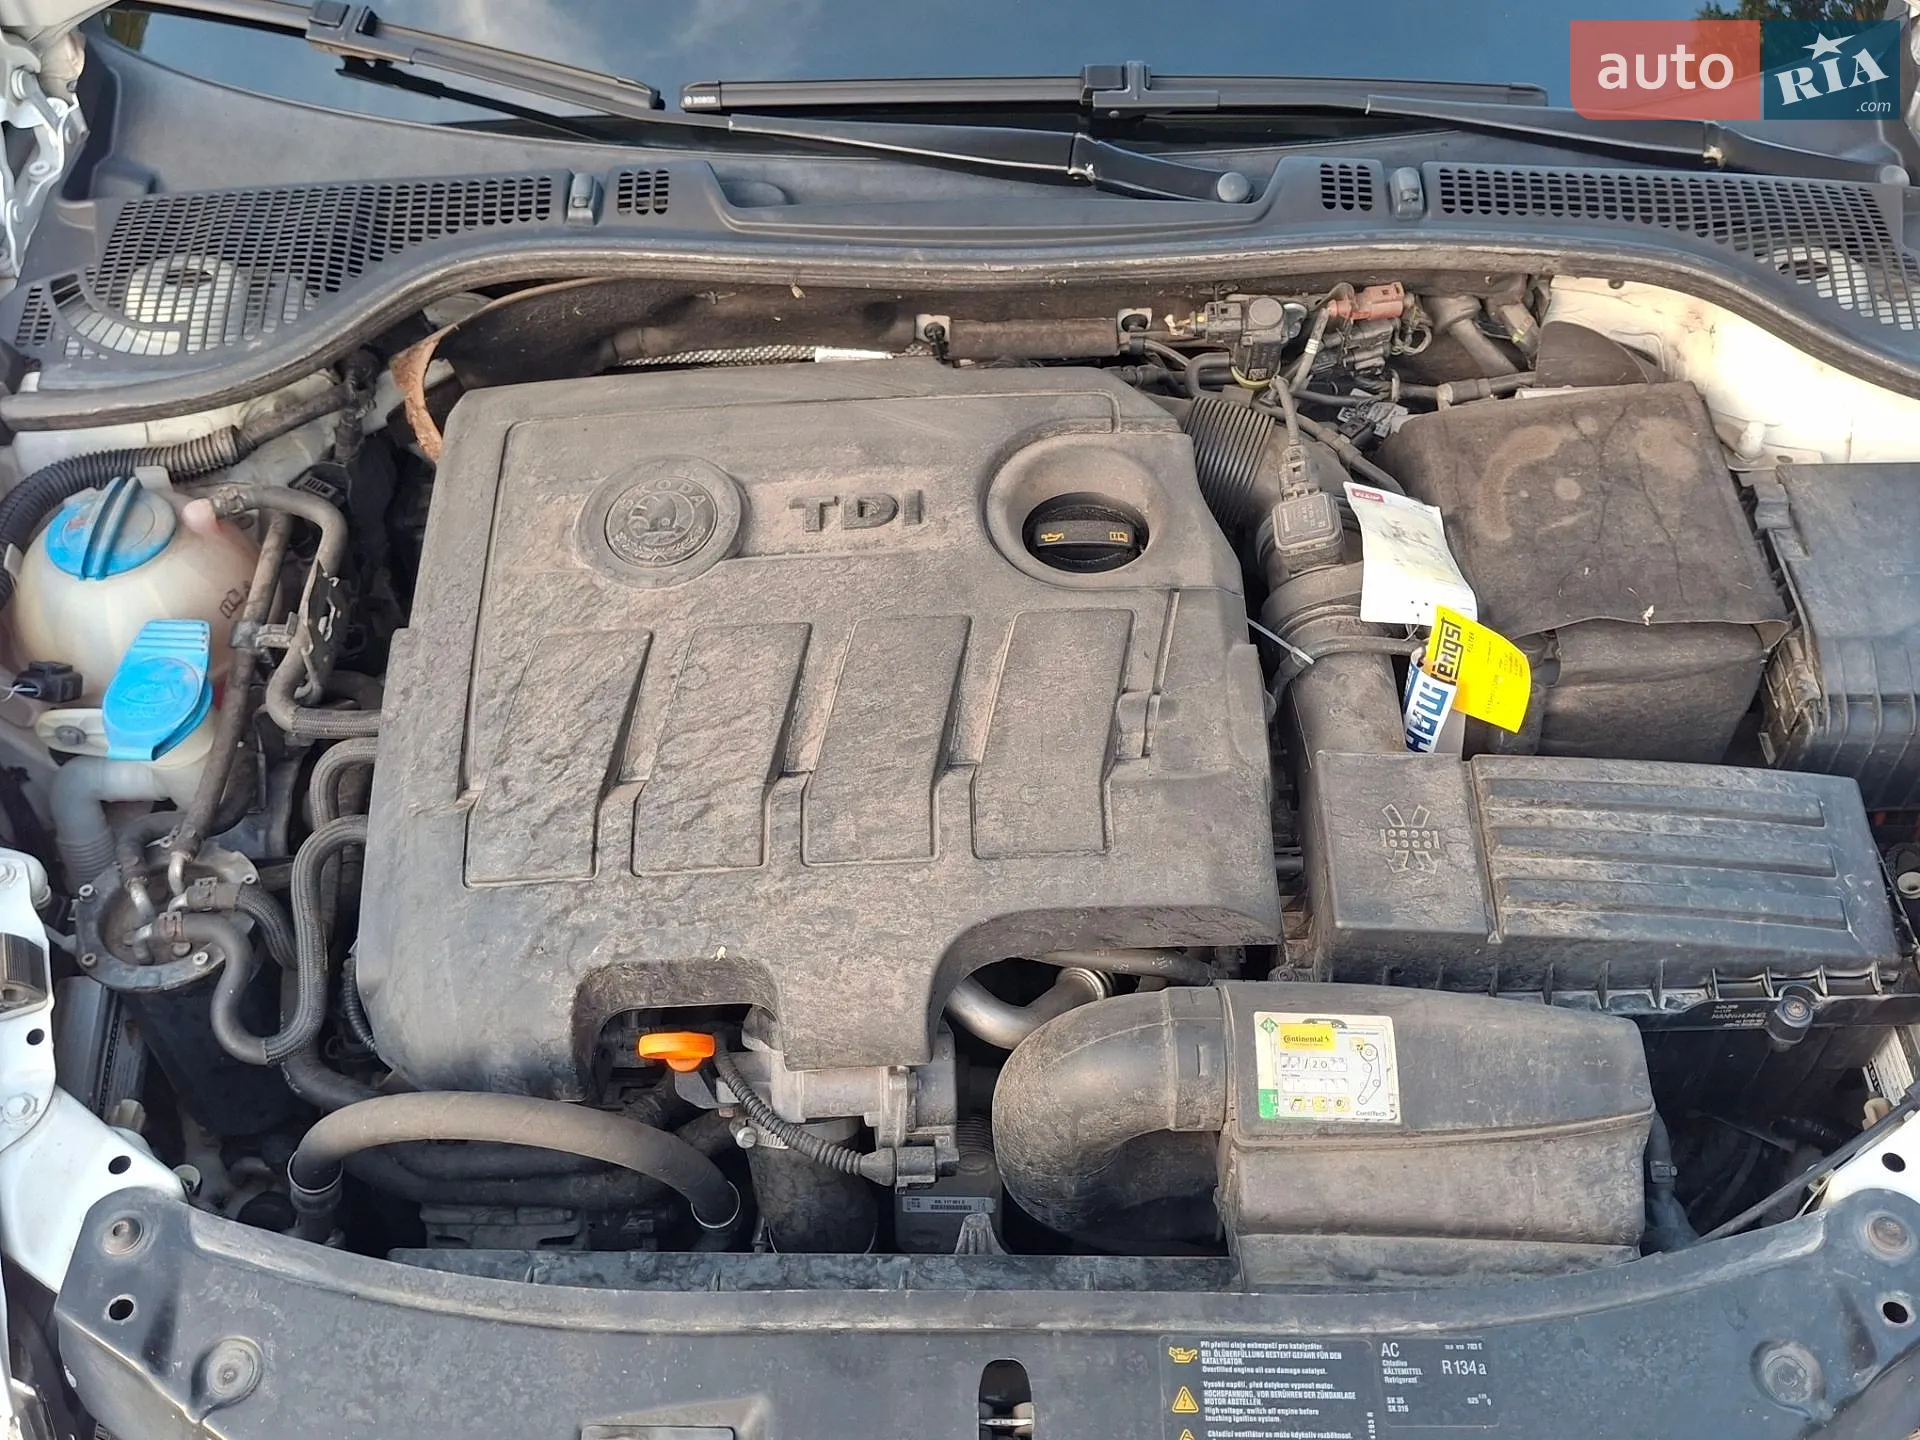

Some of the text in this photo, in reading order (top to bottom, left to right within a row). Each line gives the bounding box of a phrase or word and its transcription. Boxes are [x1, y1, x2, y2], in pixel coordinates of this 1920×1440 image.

[789, 489, 924, 533] TDI
[1283, 1034, 1324, 1043] Continental
[1381, 1342, 1400, 1357] AC
